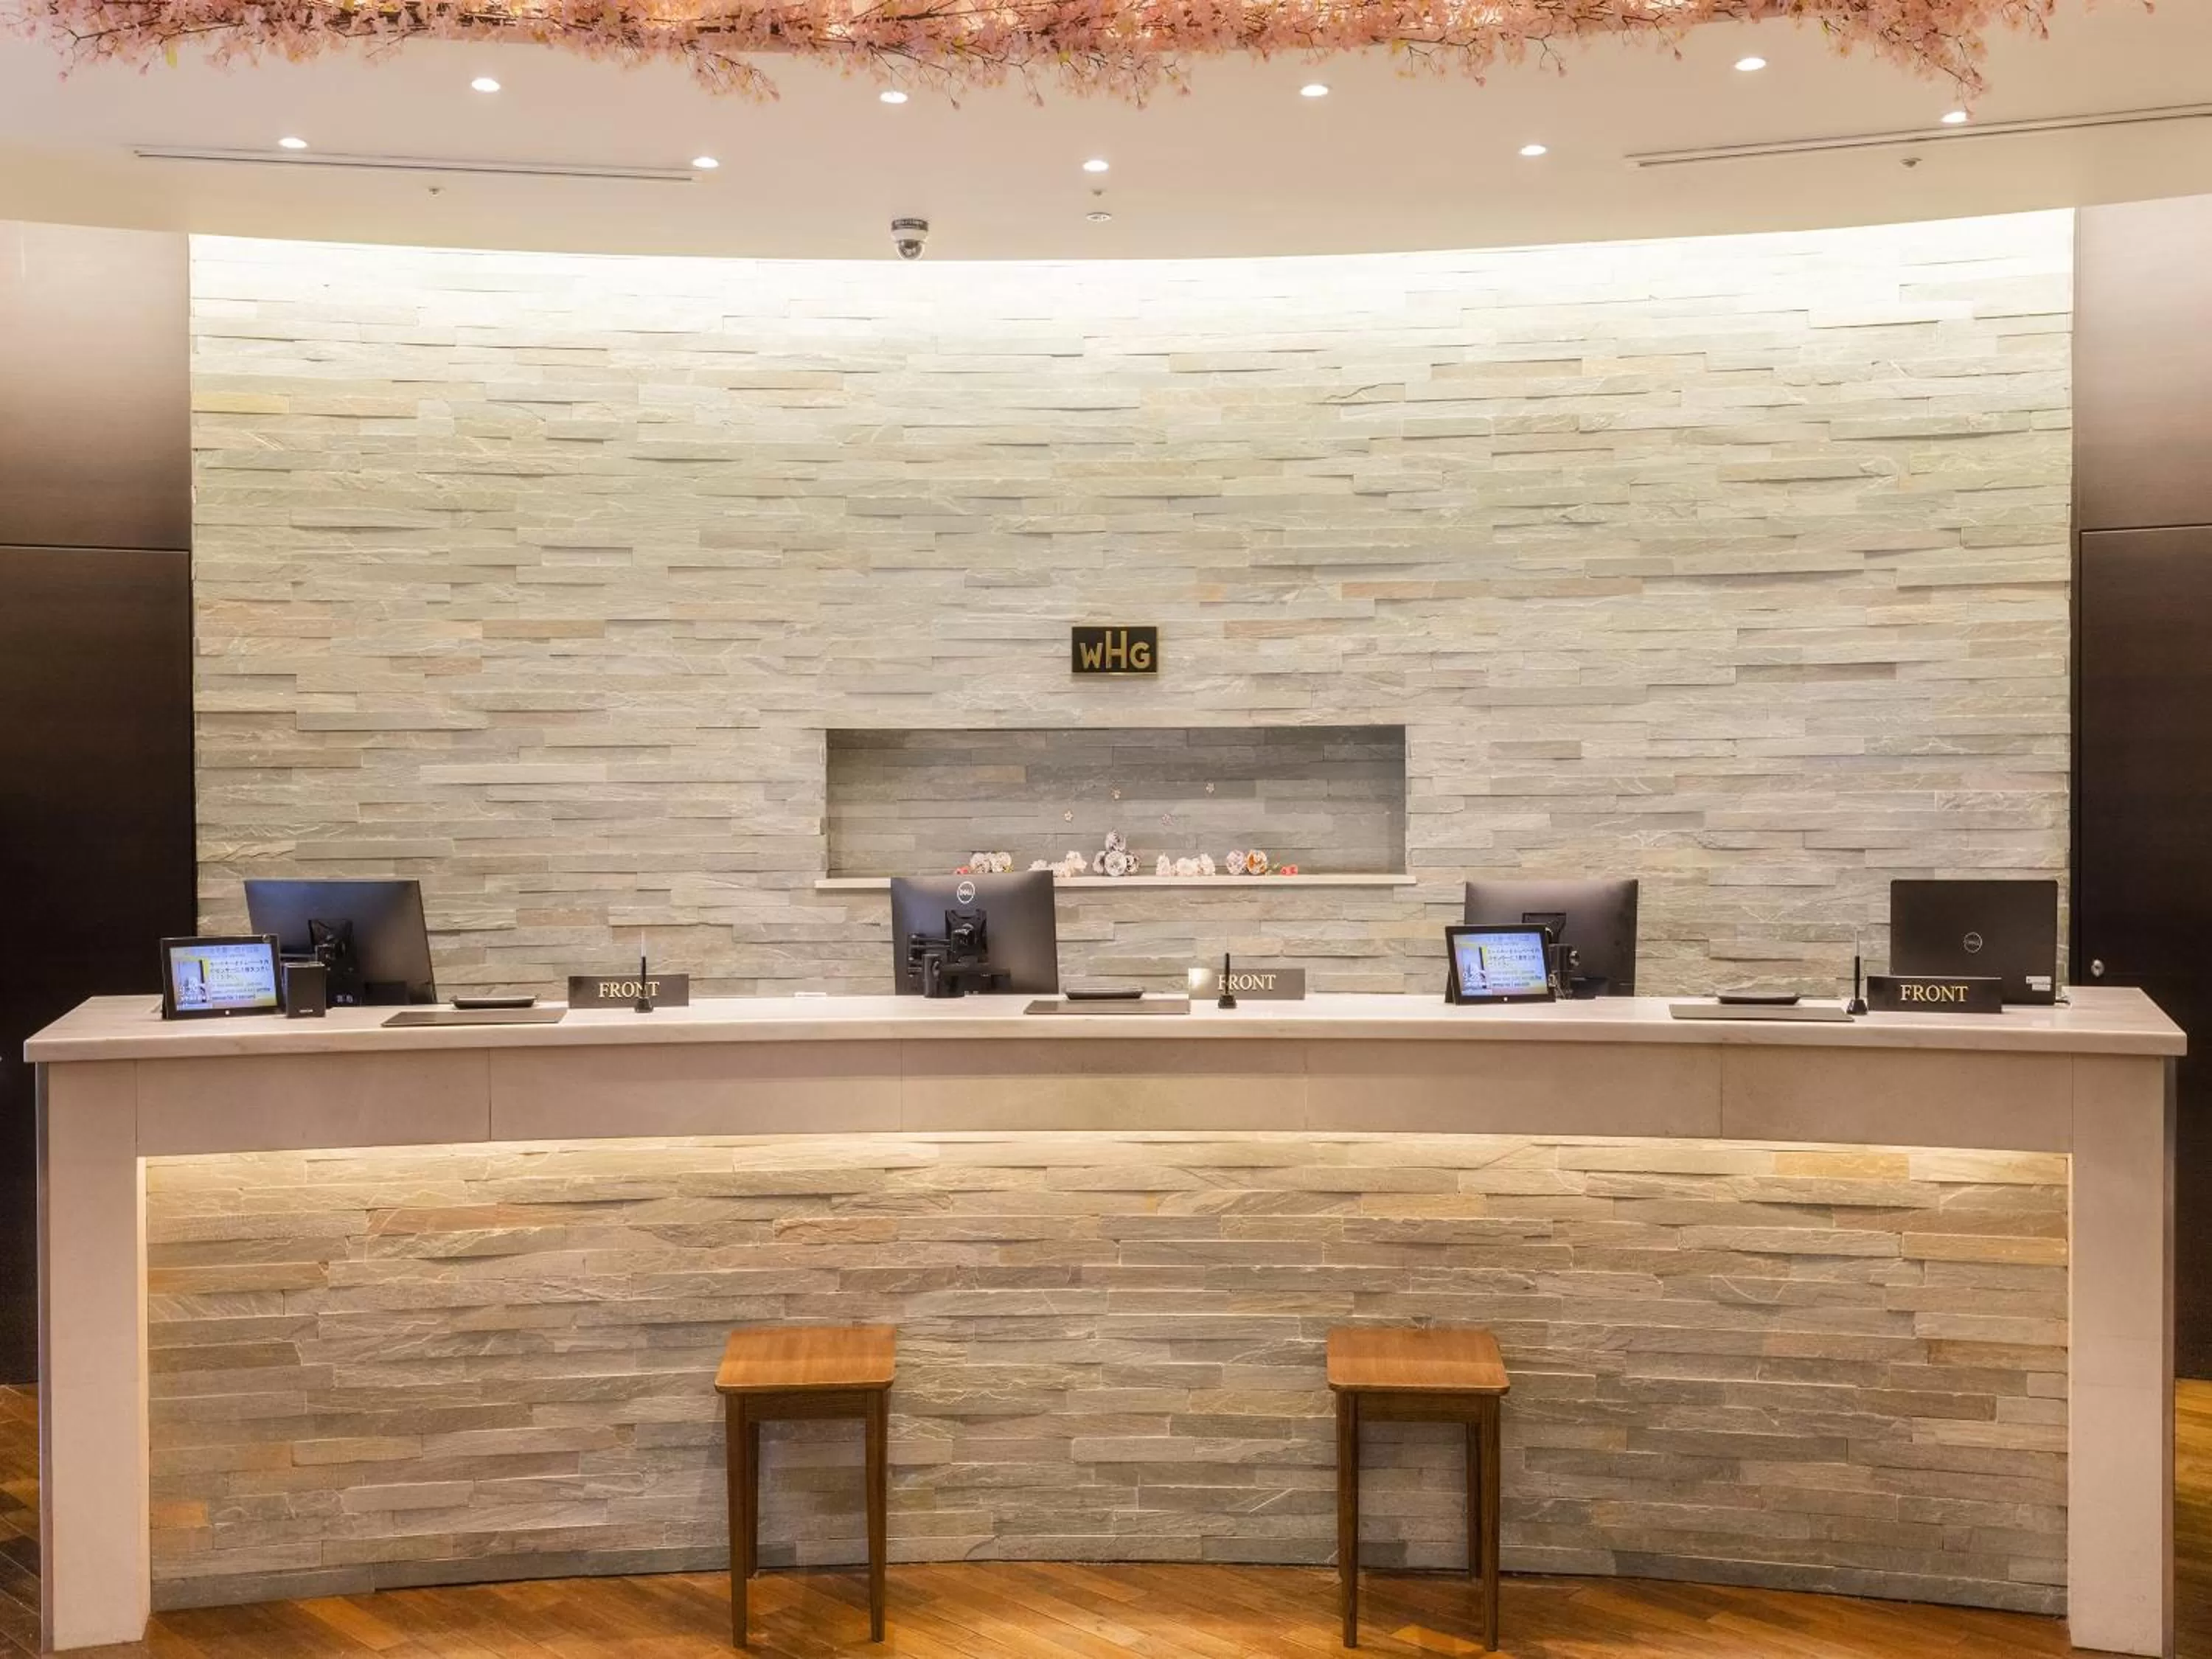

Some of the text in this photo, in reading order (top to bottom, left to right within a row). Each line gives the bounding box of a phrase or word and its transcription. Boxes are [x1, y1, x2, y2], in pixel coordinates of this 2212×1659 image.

[1079, 630, 1150, 669] WHG
[1217, 974, 1276, 990] FRONT
[1900, 984, 1969, 1002] FRONT
